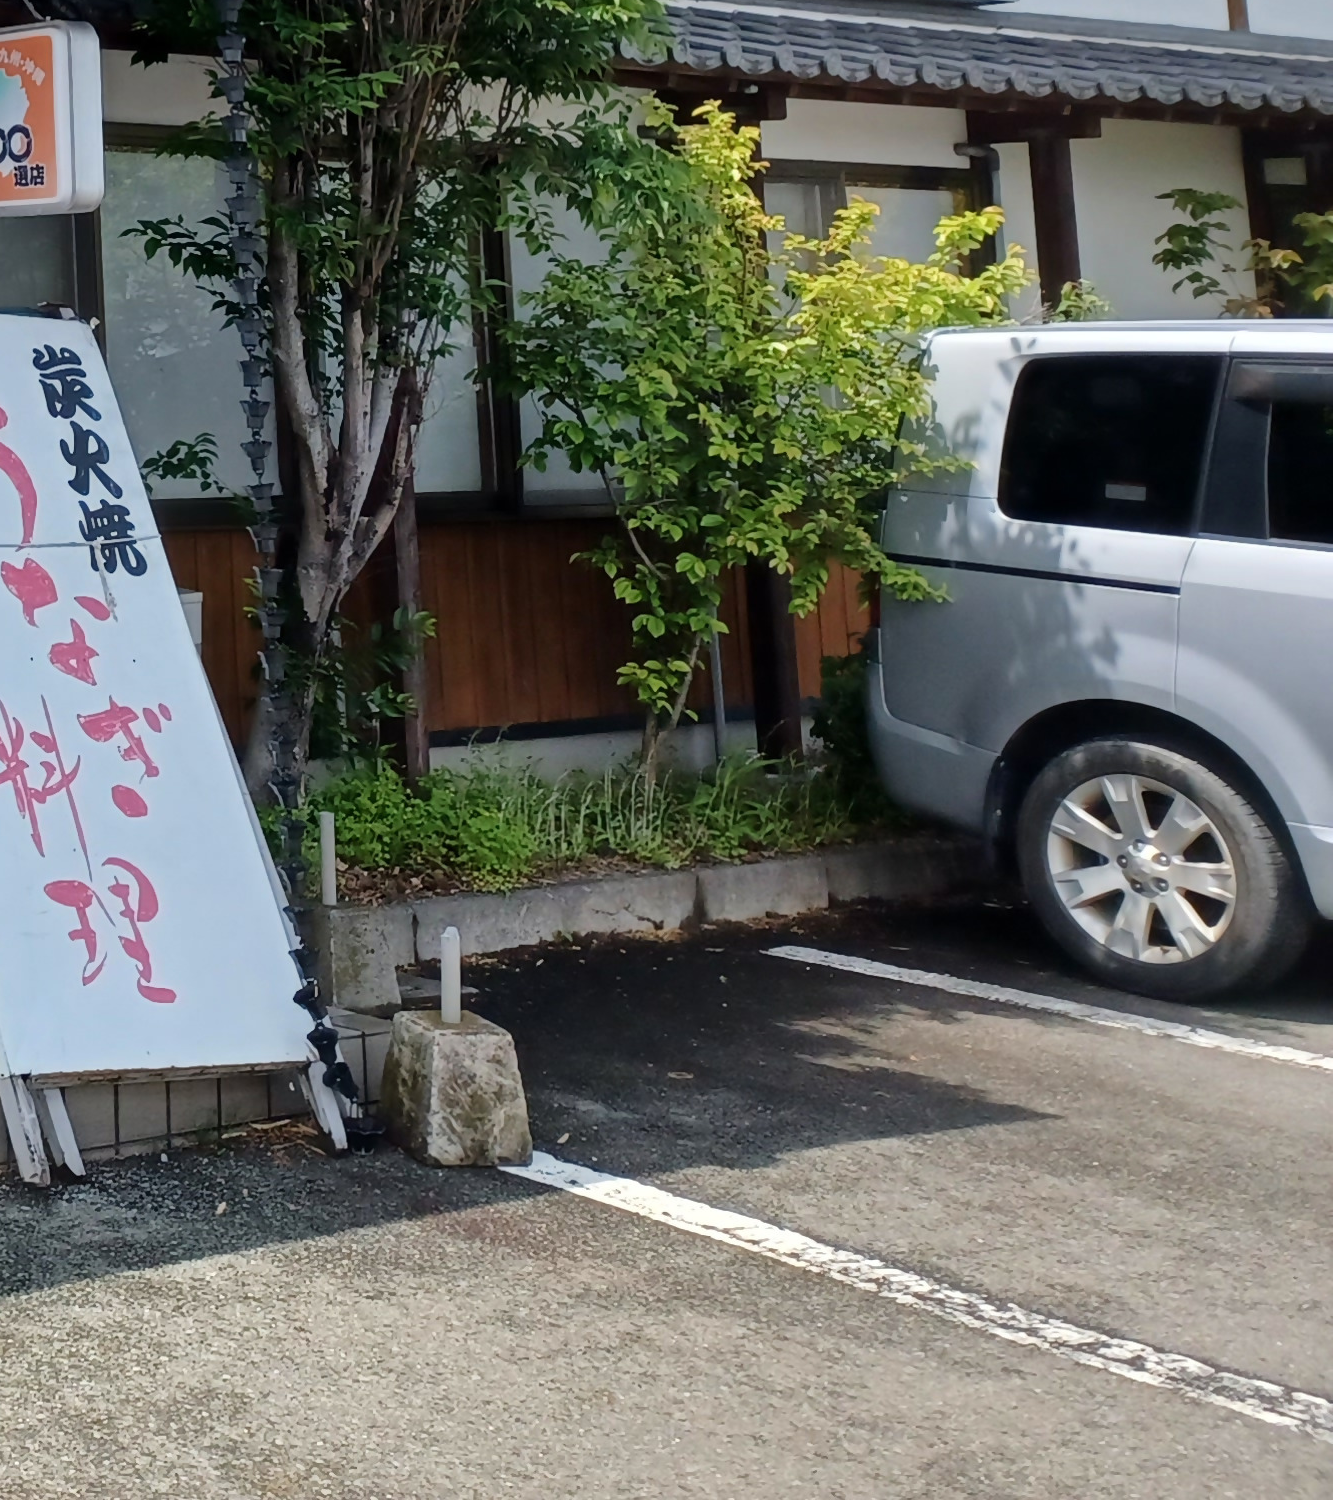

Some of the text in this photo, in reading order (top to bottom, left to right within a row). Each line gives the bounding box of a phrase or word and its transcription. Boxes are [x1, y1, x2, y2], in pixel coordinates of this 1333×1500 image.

[14, 164, 45, 188] 選店
[31, 343, 148, 577] 炭火焼
